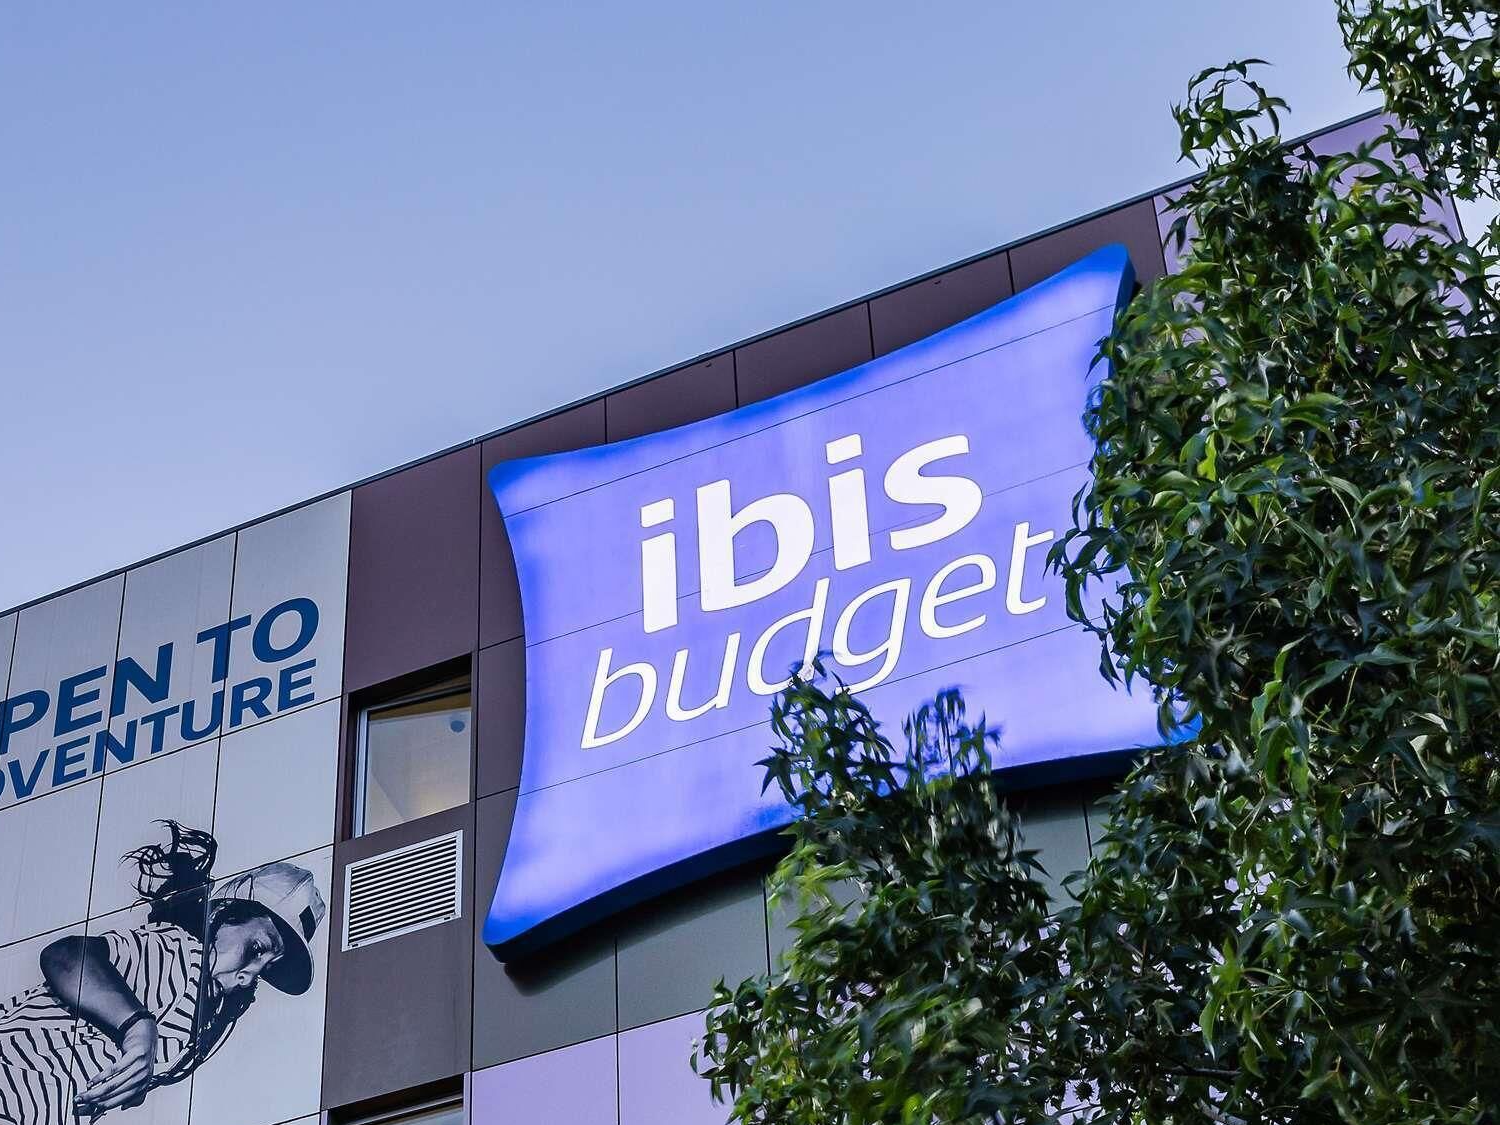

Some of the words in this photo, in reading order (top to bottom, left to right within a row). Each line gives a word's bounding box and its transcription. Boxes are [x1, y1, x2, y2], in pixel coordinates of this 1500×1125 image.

[640, 433, 984, 634] ibis
[196, 597, 320, 684] TO
[579, 521, 1056, 752] budget
